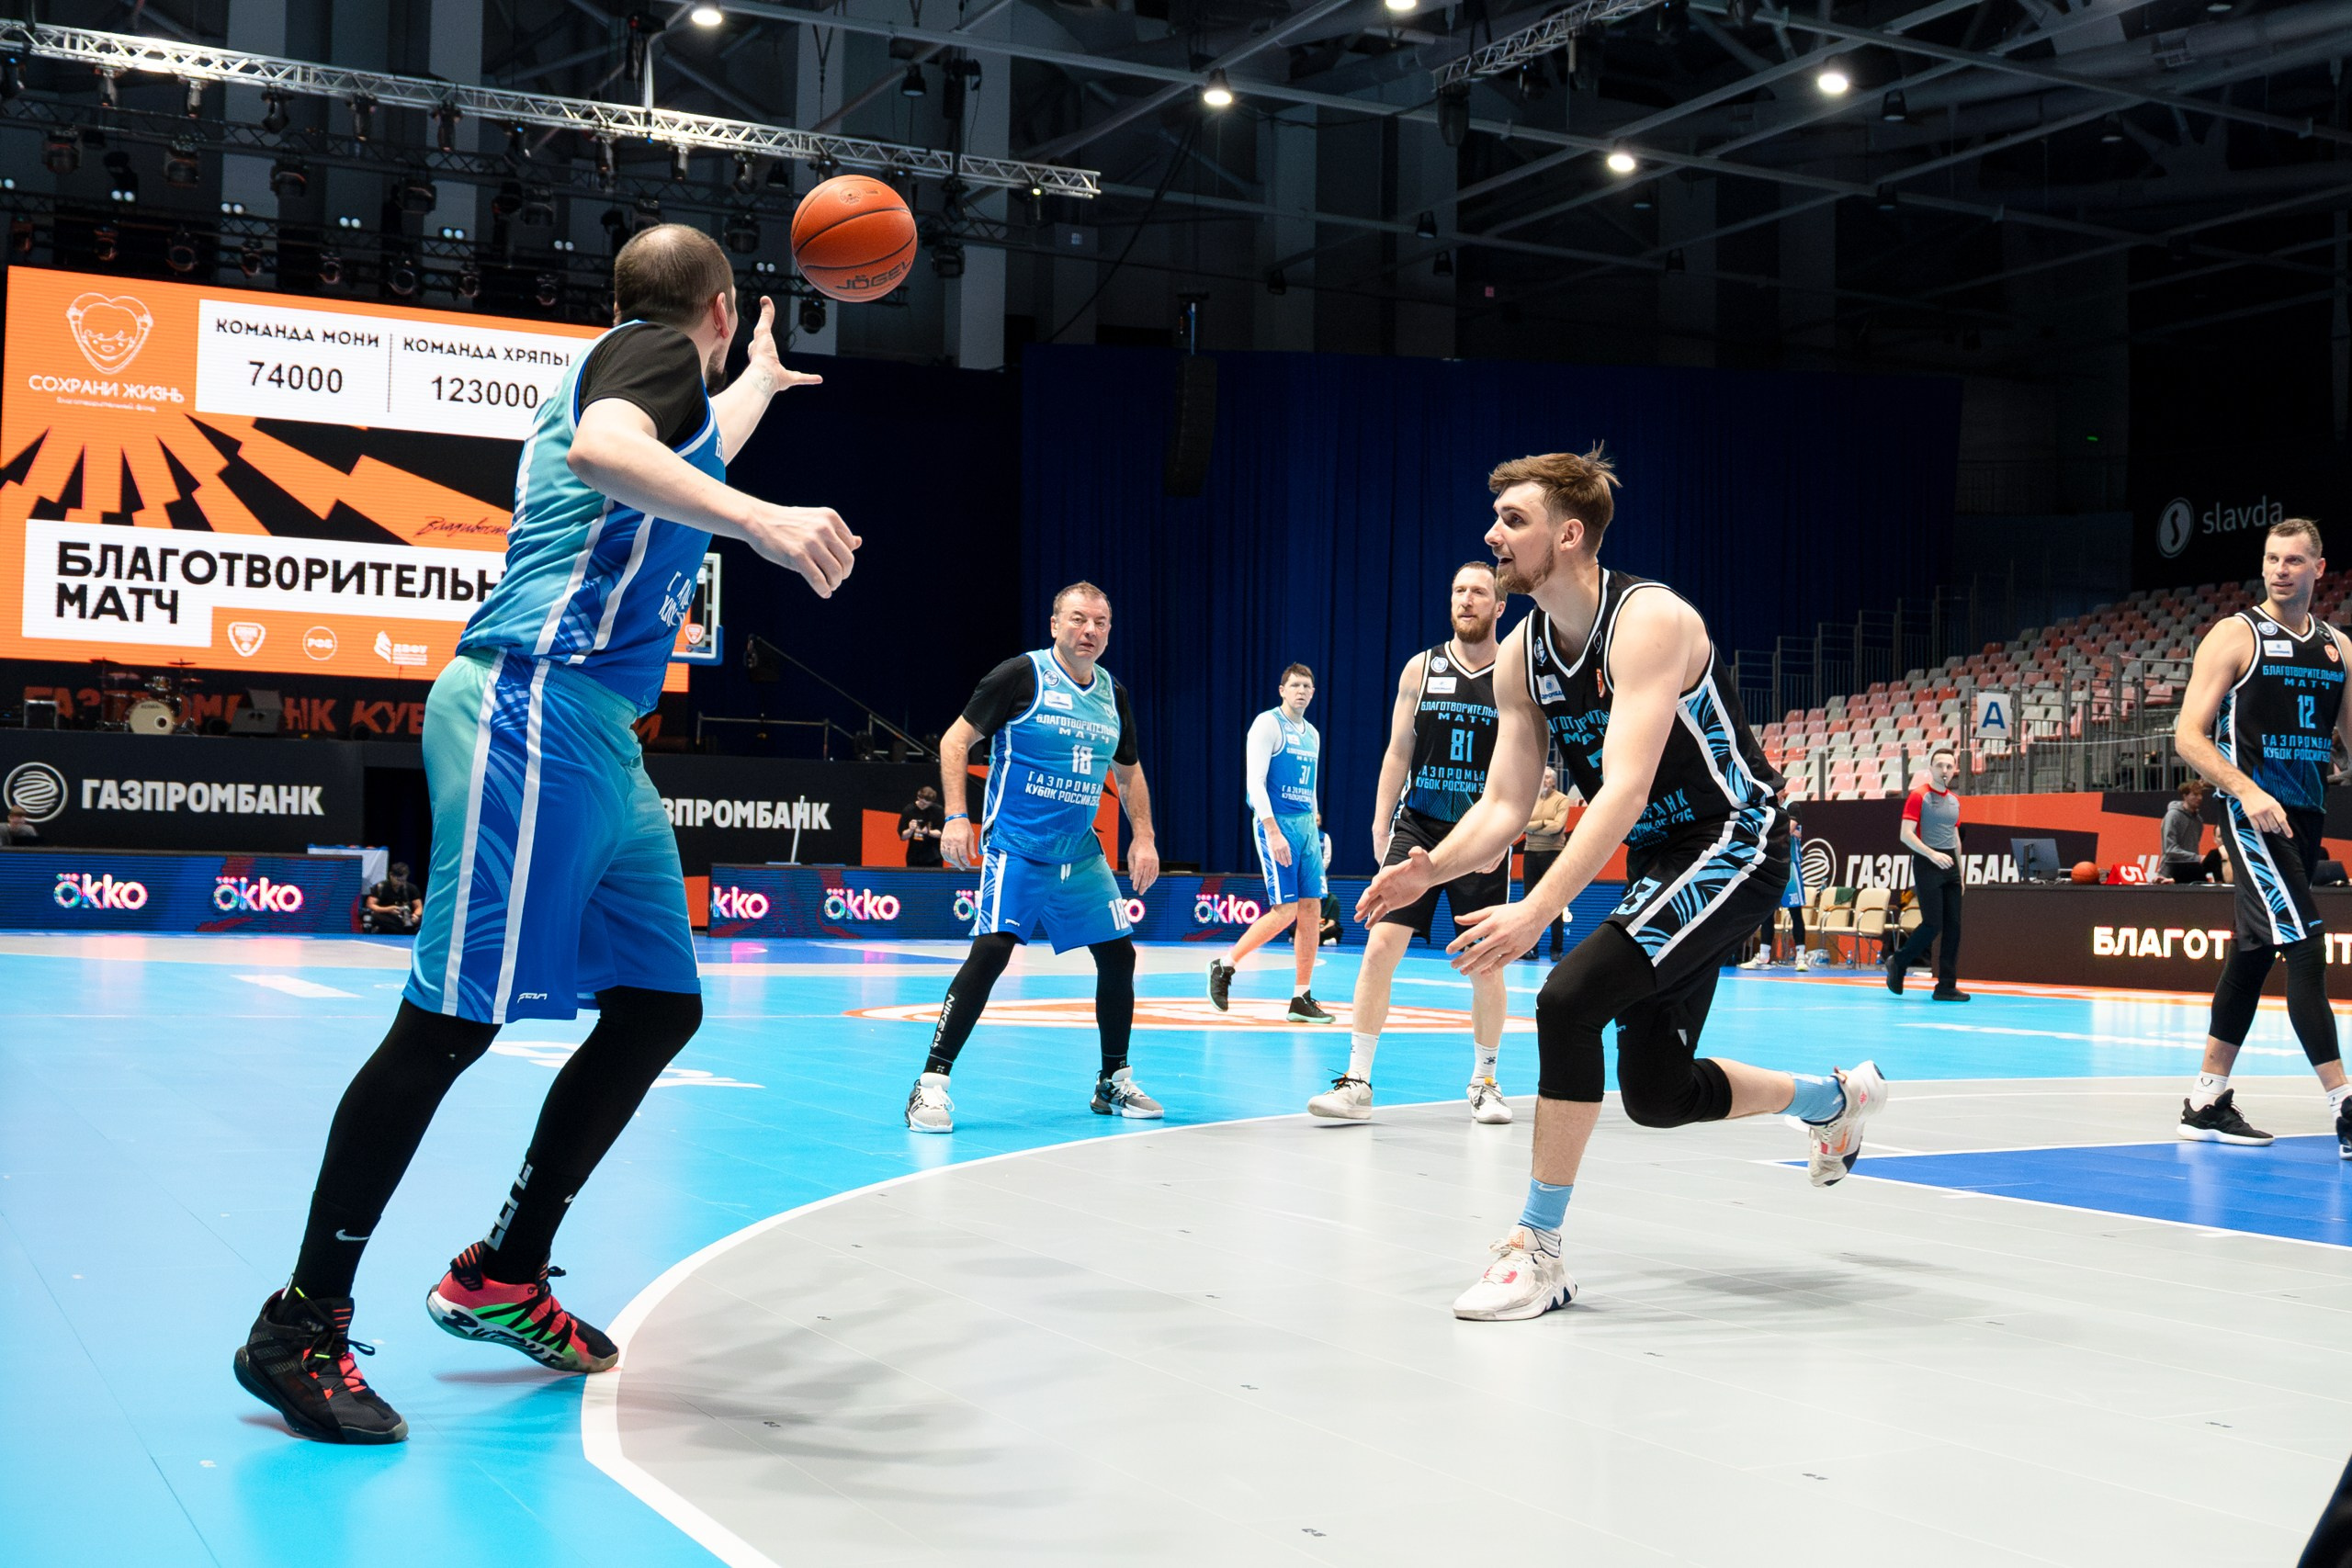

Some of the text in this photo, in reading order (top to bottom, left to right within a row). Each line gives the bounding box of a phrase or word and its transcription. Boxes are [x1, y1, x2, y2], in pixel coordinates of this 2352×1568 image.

[216, 318, 379, 348] КОМАНДА МОНИ
[403, 336, 570, 367] КОМАНДА ХРЯПЫ
[28, 375, 185, 403] СОХРАНИ ЖИЗНЬ
[248, 360, 344, 394] 74000
[431, 375, 539, 409] 123000
[2202, 495, 2283, 535] slavda
[57, 541, 506, 603] БЛАГОТВОРИТЕЛЬН
[56, 582, 179, 625] МАТЧ
[2284, 678, 2330, 690] МАТЧ
[1420, 701, 1499, 718] БЛАГОТВОРИТЕЛЬН
[1438, 712, 1490, 726] МАТЧ
[2297, 694, 2316, 729] 12
[1058, 728, 1110, 744] МАТЧ
[1450, 728, 1475, 762] 81
[1072, 745, 1093, 775] 18
[1299, 765, 1311, 784] 31
[82, 779, 325, 817] ГАЗПРОМБАНК
[1025, 783, 1057, 799] КУБОК
[1028, 771, 1103, 794] ГАЗПРОМБА
[1416, 776, 1441, 791] КУБОК
[661, 798, 831, 829] ЗПРОМБАНК
[712, 886, 770, 919] kko
[938, 993, 956, 1031] NIKE
